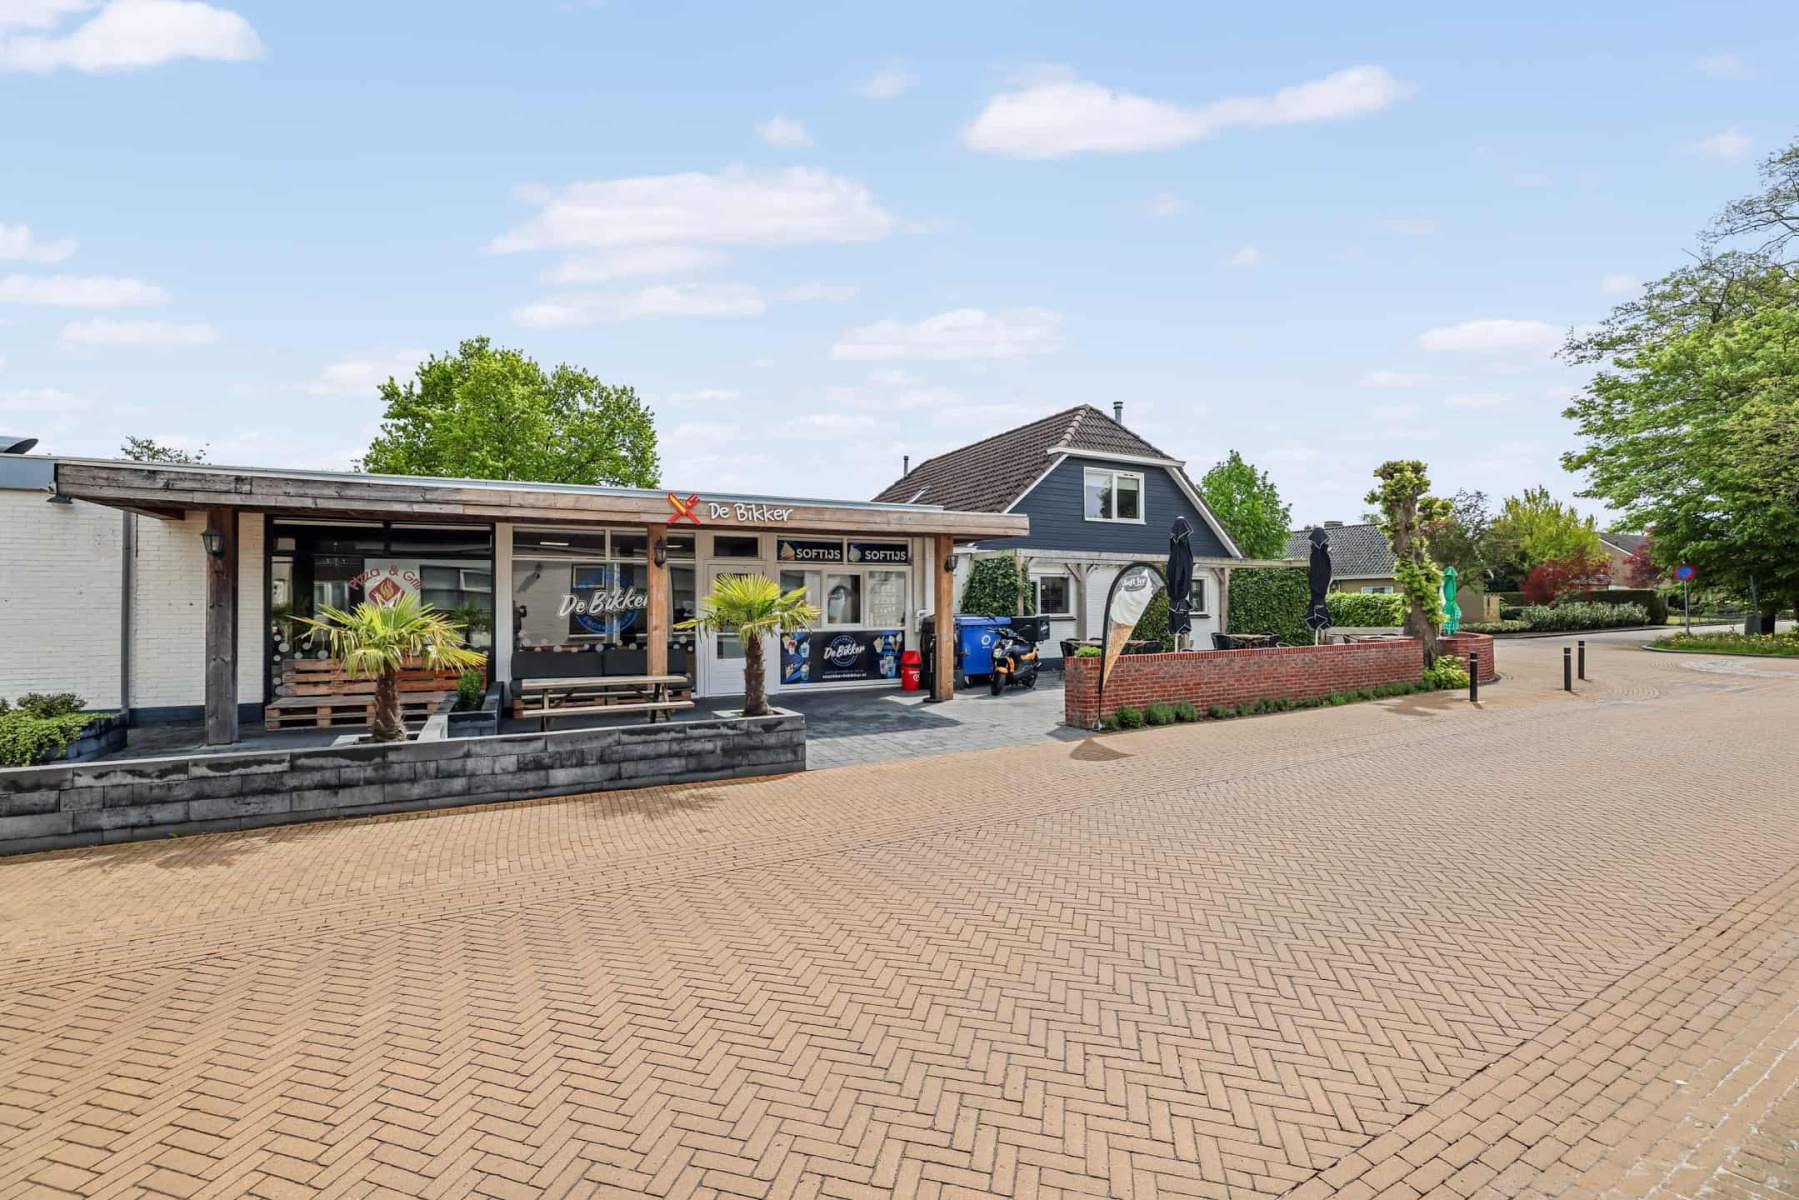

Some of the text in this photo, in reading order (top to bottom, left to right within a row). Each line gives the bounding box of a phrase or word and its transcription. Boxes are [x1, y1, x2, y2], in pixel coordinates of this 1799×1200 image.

[708, 502, 793, 522] De Bikker
[796, 549, 841, 559] SOFTIJS
[865, 550, 906, 560] SOFTIJS
[348, 565, 425, 591] Pizza & Grill
[559, 594, 586, 617] De
[823, 643, 866, 659] De Bikker
